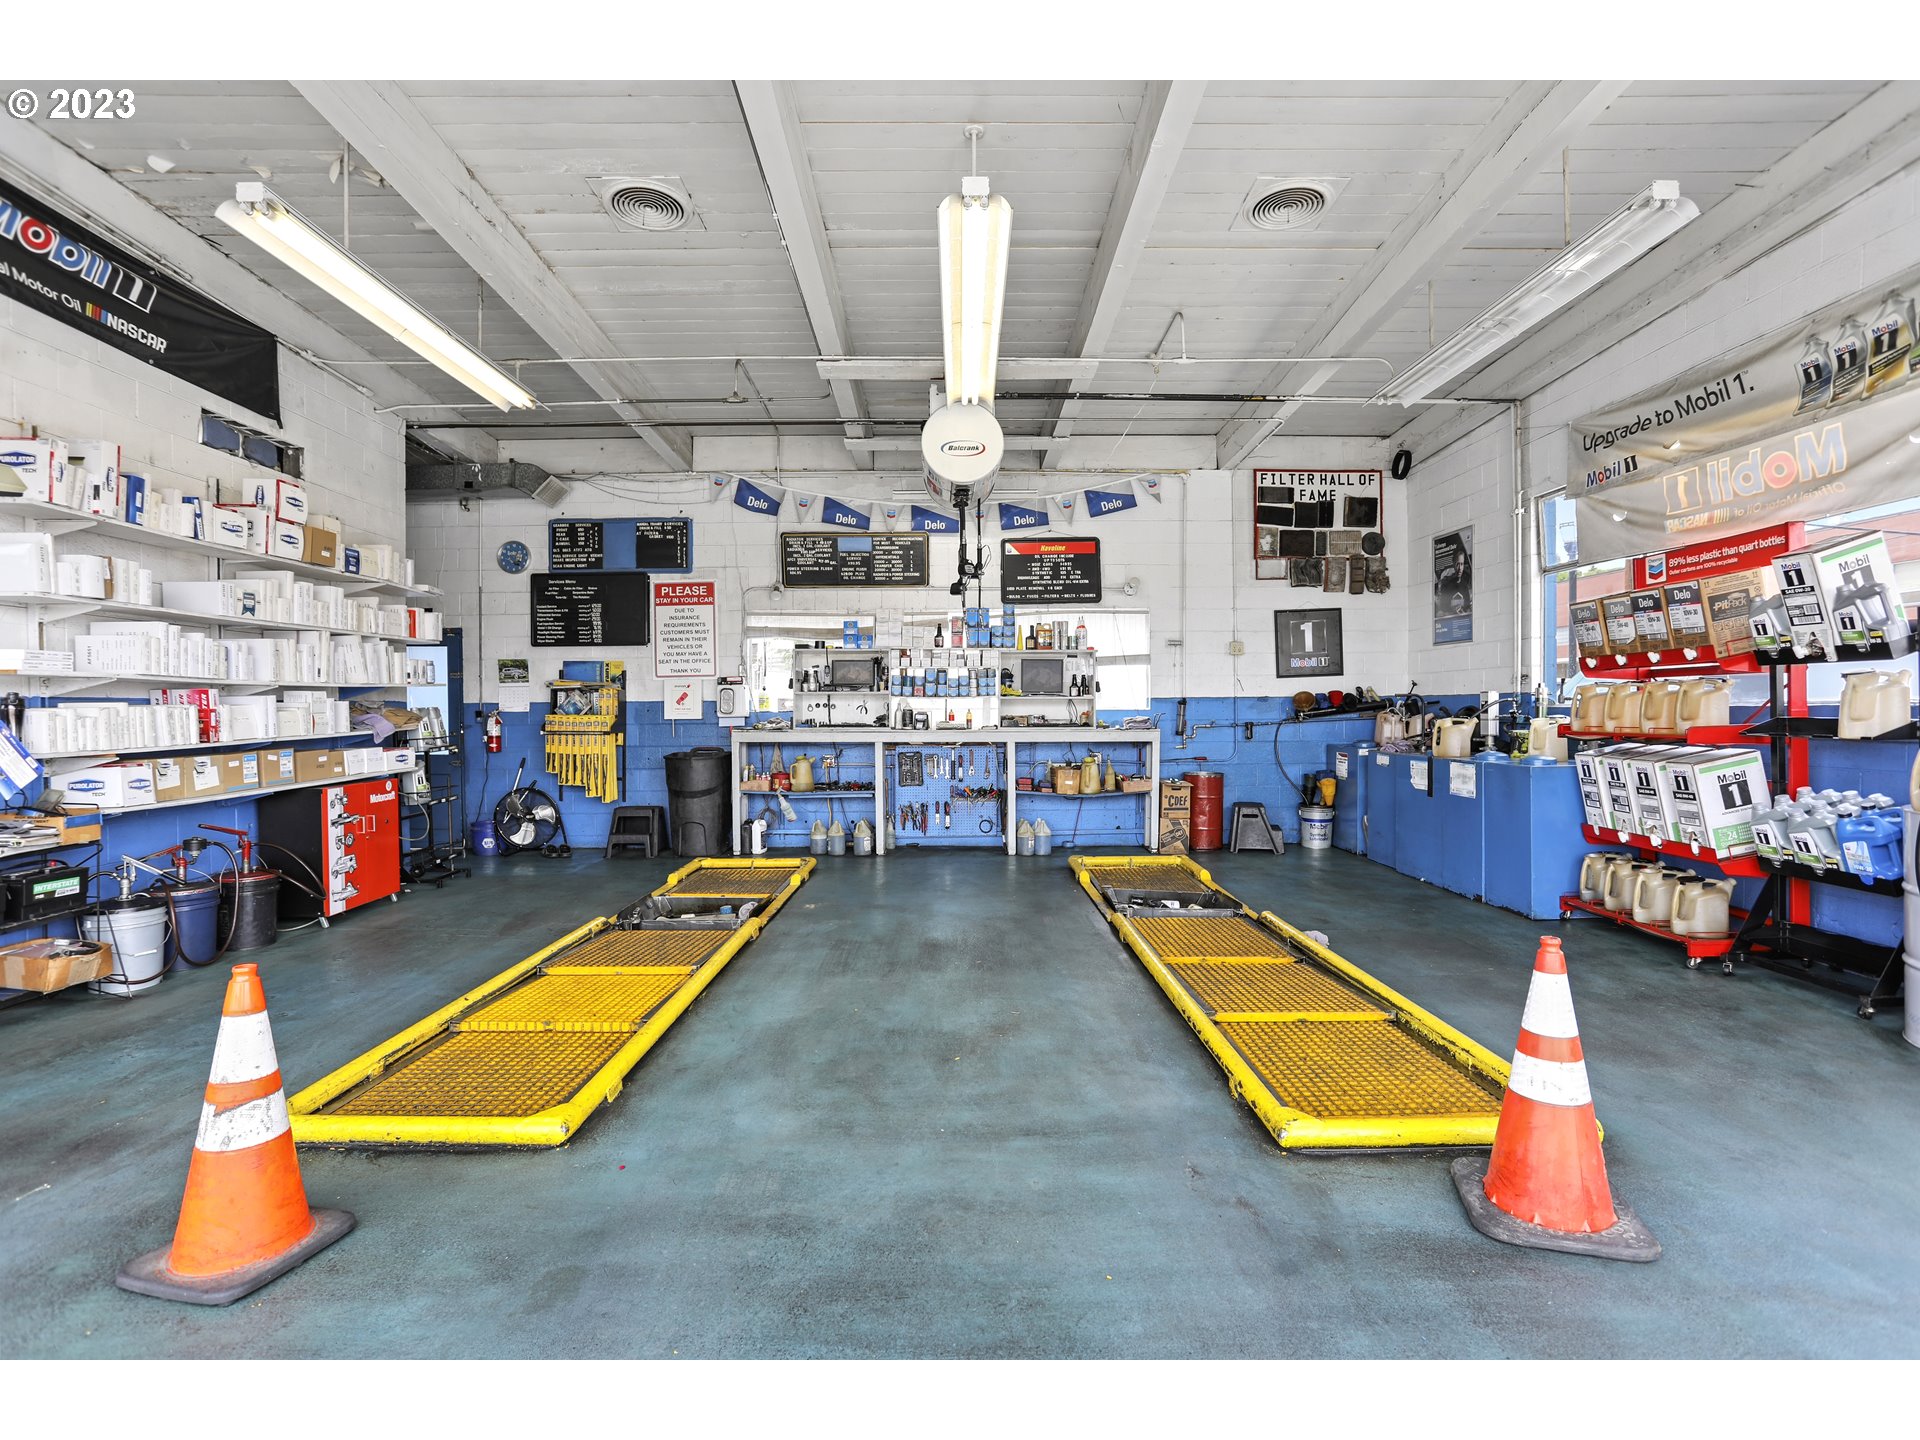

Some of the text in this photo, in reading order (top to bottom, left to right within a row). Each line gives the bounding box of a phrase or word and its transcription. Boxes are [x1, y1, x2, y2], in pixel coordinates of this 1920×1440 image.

[11, 266, 168, 354] Motor Oil NASCAR
[1871, 319, 1899, 336] Mobil
[1833, 341, 1856, 355] Mobil
[1800, 357, 1820, 369] Mobil
[1583, 414, 1653, 453] Upgrade
[1655, 409, 1674, 427] to
[1674, 378, 1731, 419] Mobil
[1260, 473, 1376, 485] FILTER HALL OF
[1586, 459, 1621, 488] Mobil
[1300, 490, 1336, 500] FAME
[746, 495, 769, 512] Delo
[1101, 498, 1123, 512] Delo
[835, 512, 857, 526] Delo
[924, 520, 946, 530] Delo
[1013, 514, 1036, 527] Delo
[1668, 535, 1786, 568] 89% less plastic than quart bottles
[1716, 558, 1738, 566] recyclable
[1781, 561, 1801, 570] Mobil
[1838, 554, 1870, 572] Mobil
[662, 586, 707, 596] PLEASE
[1674, 590, 1691, 600] Delo
[1610, 604, 1624, 614] Delo
[1638, 598, 1654, 608] Delo
[1578, 610, 1590, 618] Delo
[1300, 622, 1313, 652] 1
[1290, 658, 1317, 667] Mobil
[1717, 770, 1747, 784] Mobil
[370, 790, 396, 803] Motorcraft
[1728, 831, 1738, 840] 24
[34, 879, 80, 894] INTERSTATE
